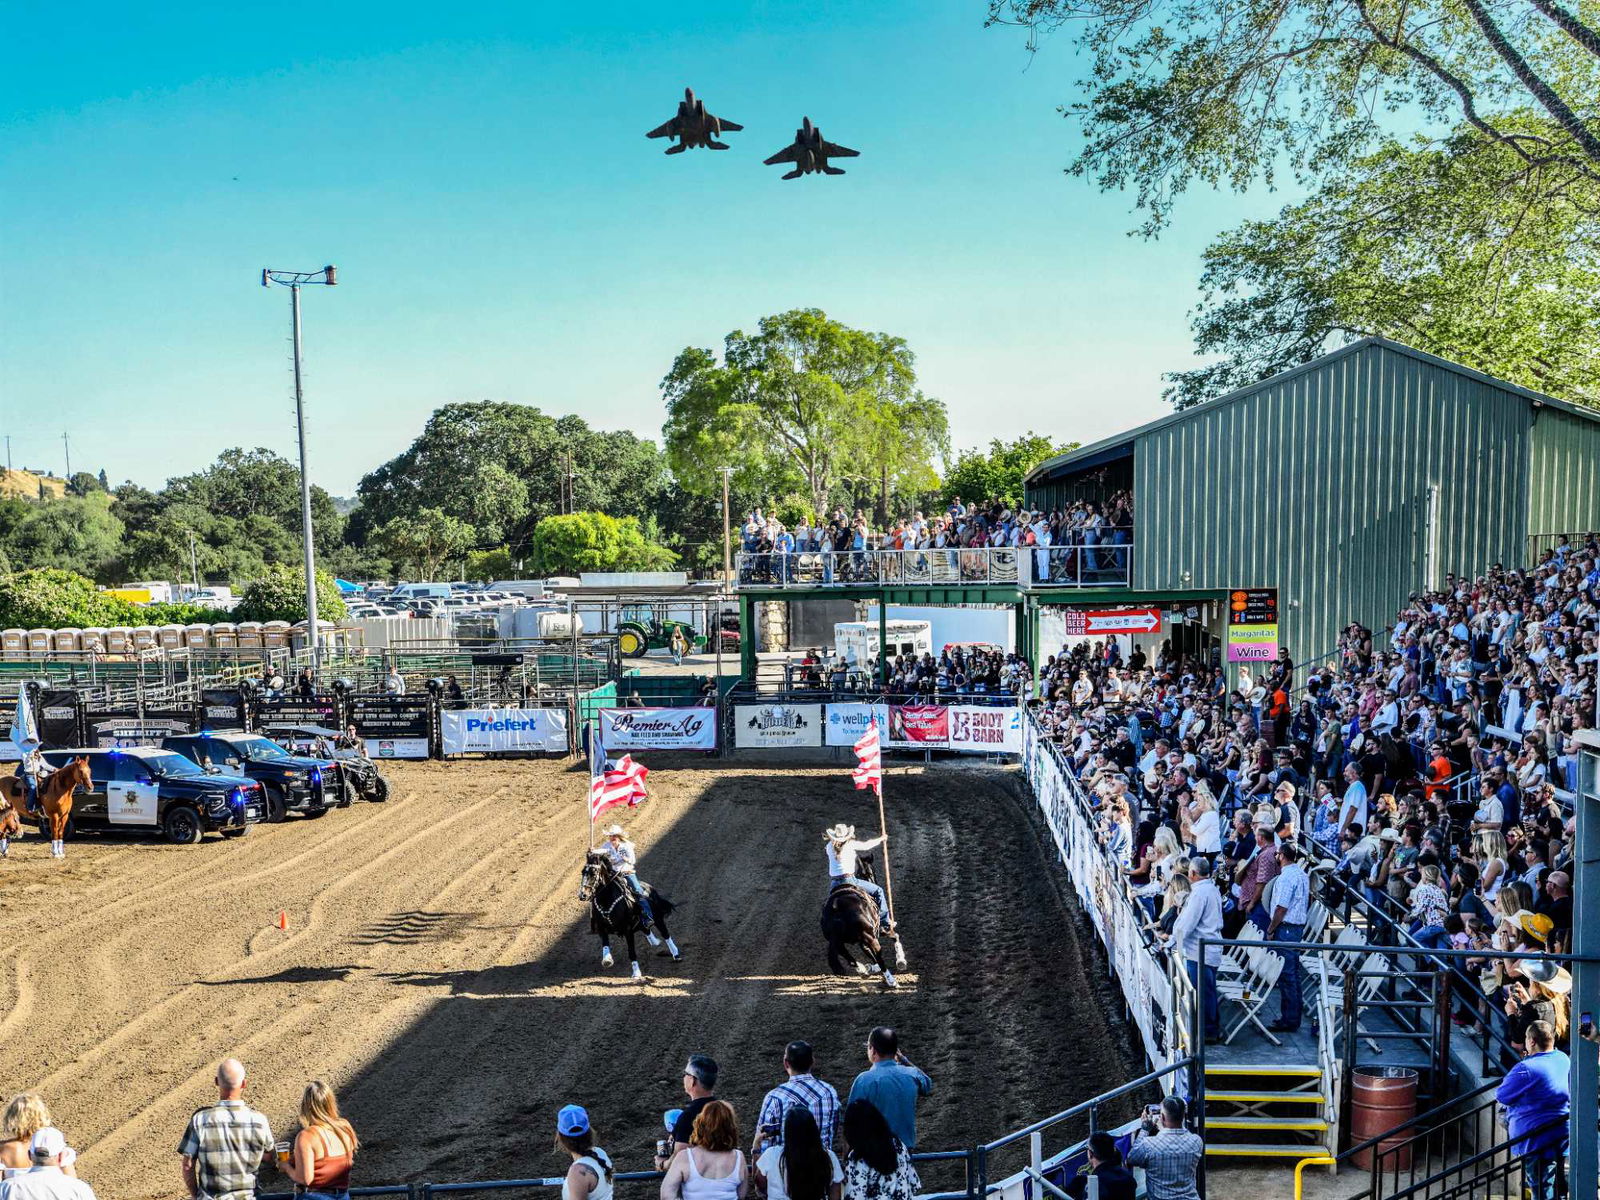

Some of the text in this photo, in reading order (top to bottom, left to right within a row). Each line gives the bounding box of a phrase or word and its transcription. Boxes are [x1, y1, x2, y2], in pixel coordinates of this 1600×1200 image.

[1067, 627, 1087, 635] HERE
[1231, 630, 1275, 638] Margaritas
[1236, 647, 1269, 657] Wine
[467, 716, 536, 732] Priefert
[612, 713, 704, 737] Premier Ag
[842, 712, 886, 727] wellph
[972, 713, 1004, 728] BOOT
[972, 729, 1004, 743] BARN
